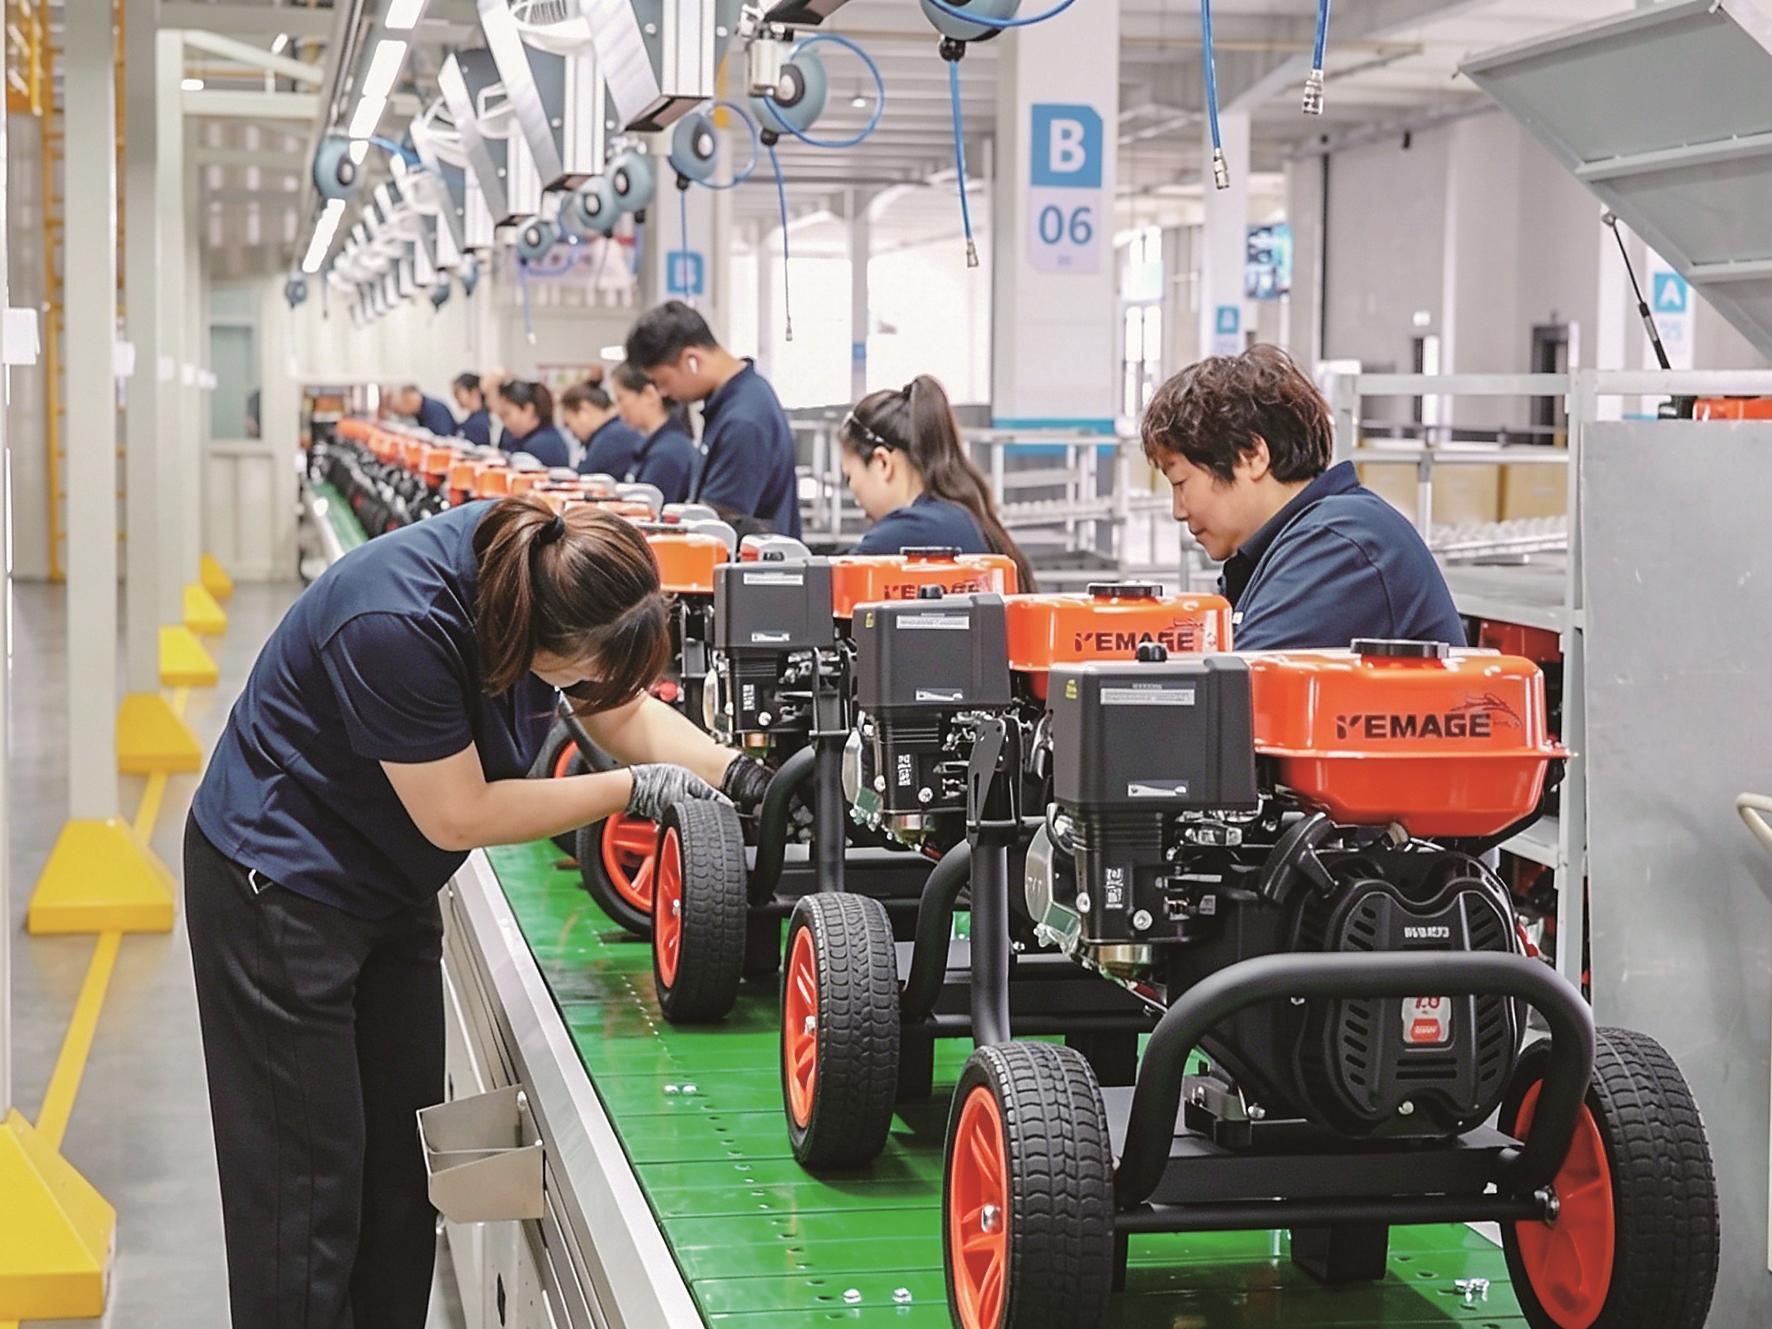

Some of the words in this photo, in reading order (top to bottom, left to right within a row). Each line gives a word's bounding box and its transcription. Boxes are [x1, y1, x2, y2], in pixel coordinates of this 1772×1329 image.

[1049, 118, 1086, 172] B
[1039, 205, 1093, 245] 06
[1660, 279, 1682, 306] A
[1336, 714, 1491, 739] YEMAGE
